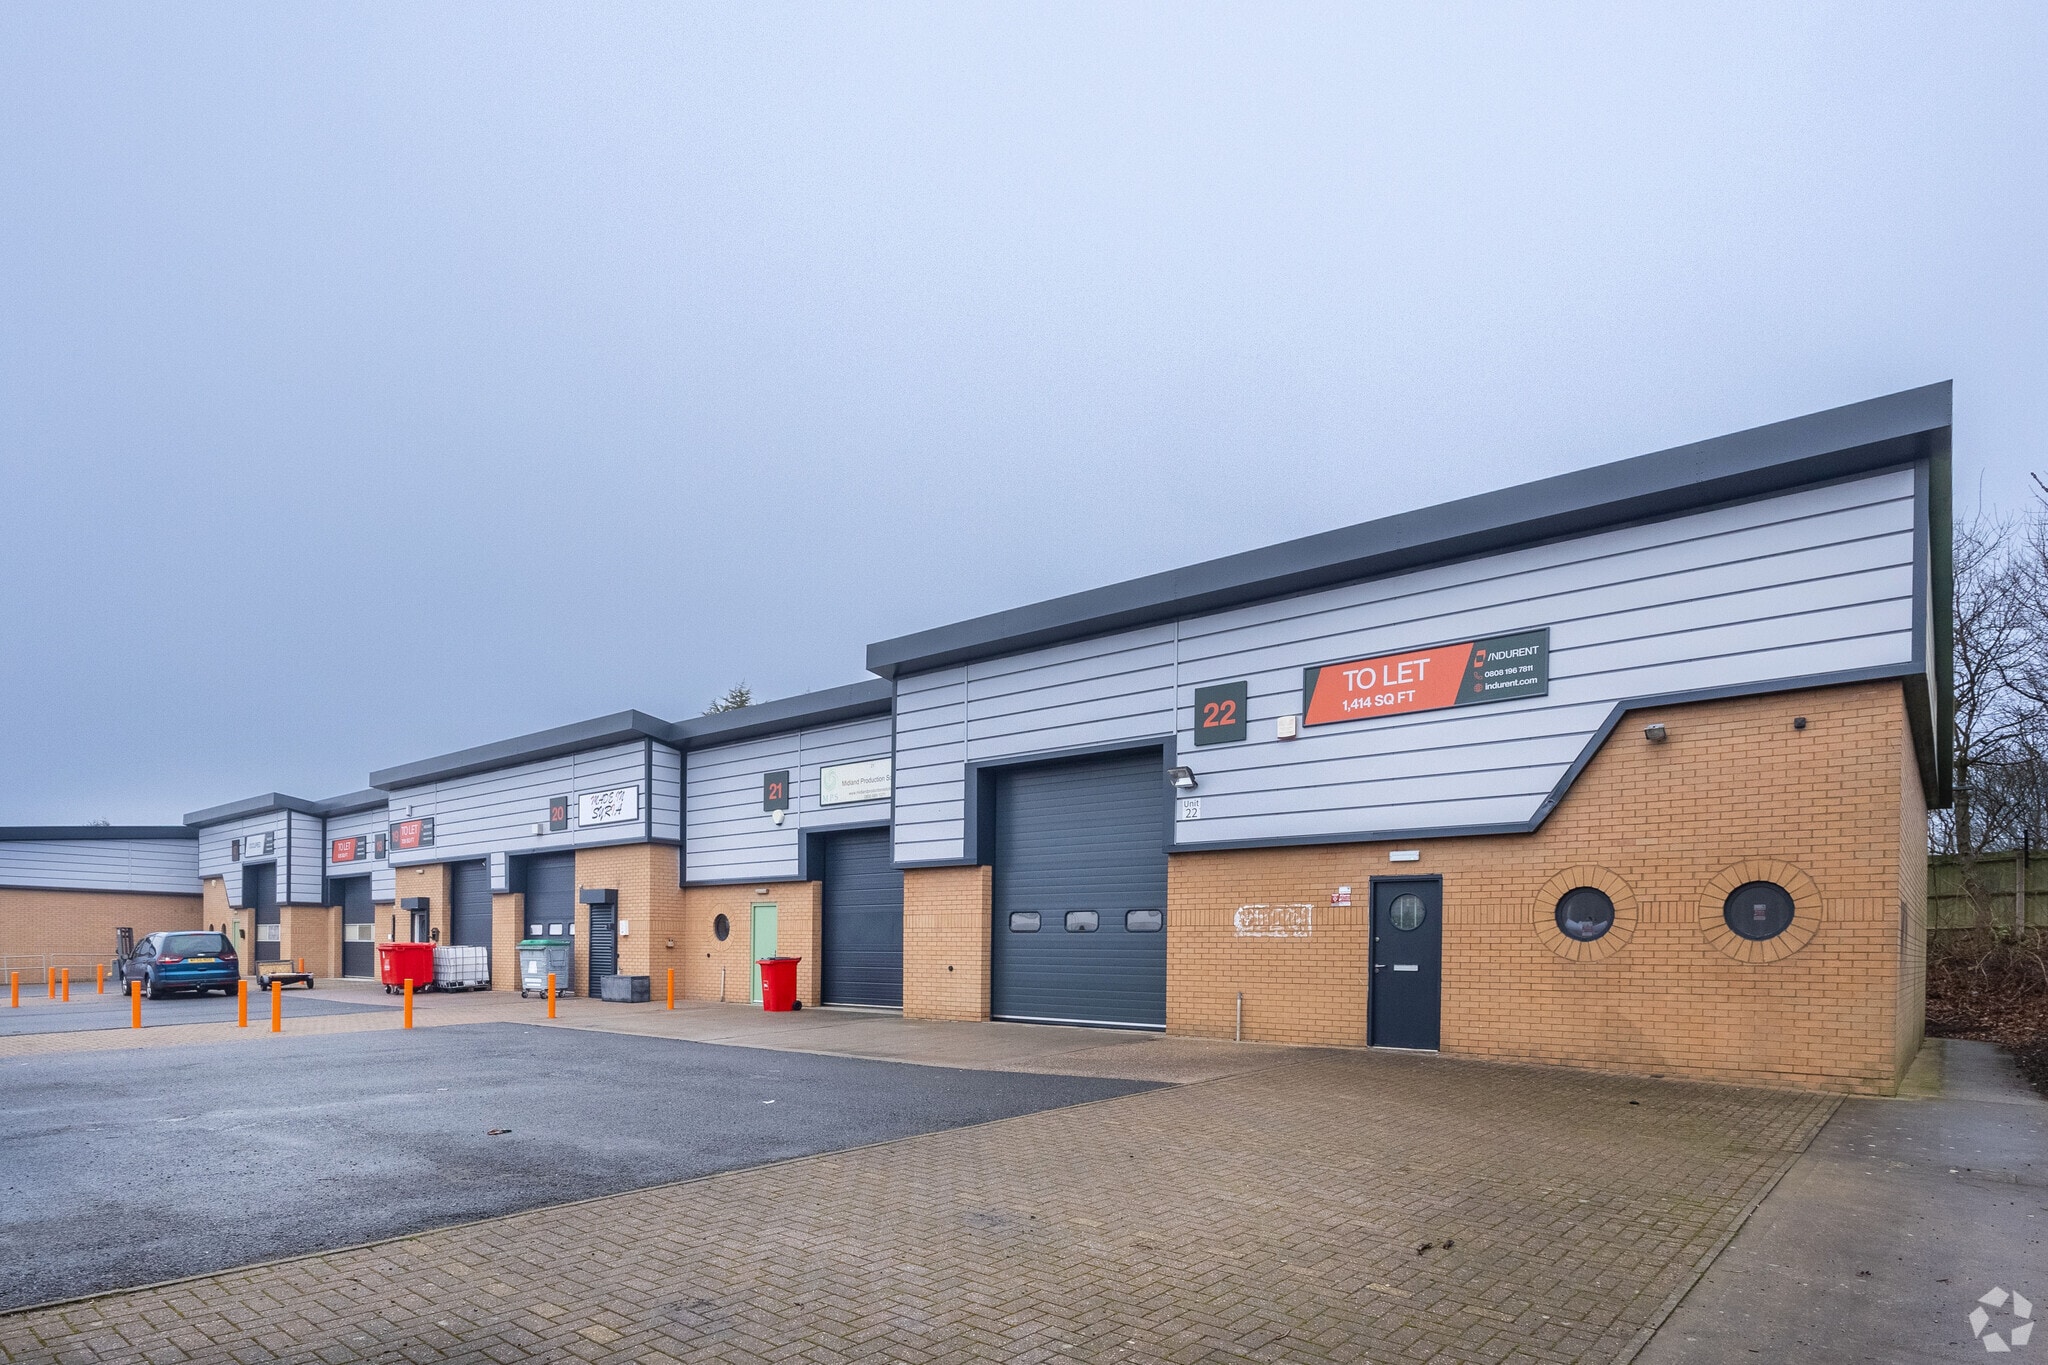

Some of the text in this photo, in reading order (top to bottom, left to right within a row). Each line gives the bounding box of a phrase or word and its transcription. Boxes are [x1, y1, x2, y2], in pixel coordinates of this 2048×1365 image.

[1343, 658, 1430, 691] TO LET
[1484, 665, 1534, 678] 0808 196 7811
[1485, 677, 1538, 690] indurent.com
[1342, 690, 1416, 712] 1,414 SQ FT
[1203, 700, 1237, 728] 22
[861, 775, 885, 785] Production
[769, 782, 783, 800] 21
[591, 792, 614, 805] MADE
[1183, 800, 1199, 808] Unit
[551, 806, 564, 822] 20
[592, 803, 622, 821] SYRIA
[1185, 808, 1198, 819] 22
[401, 826, 409, 836] TO
[409, 824, 418, 834] LET
